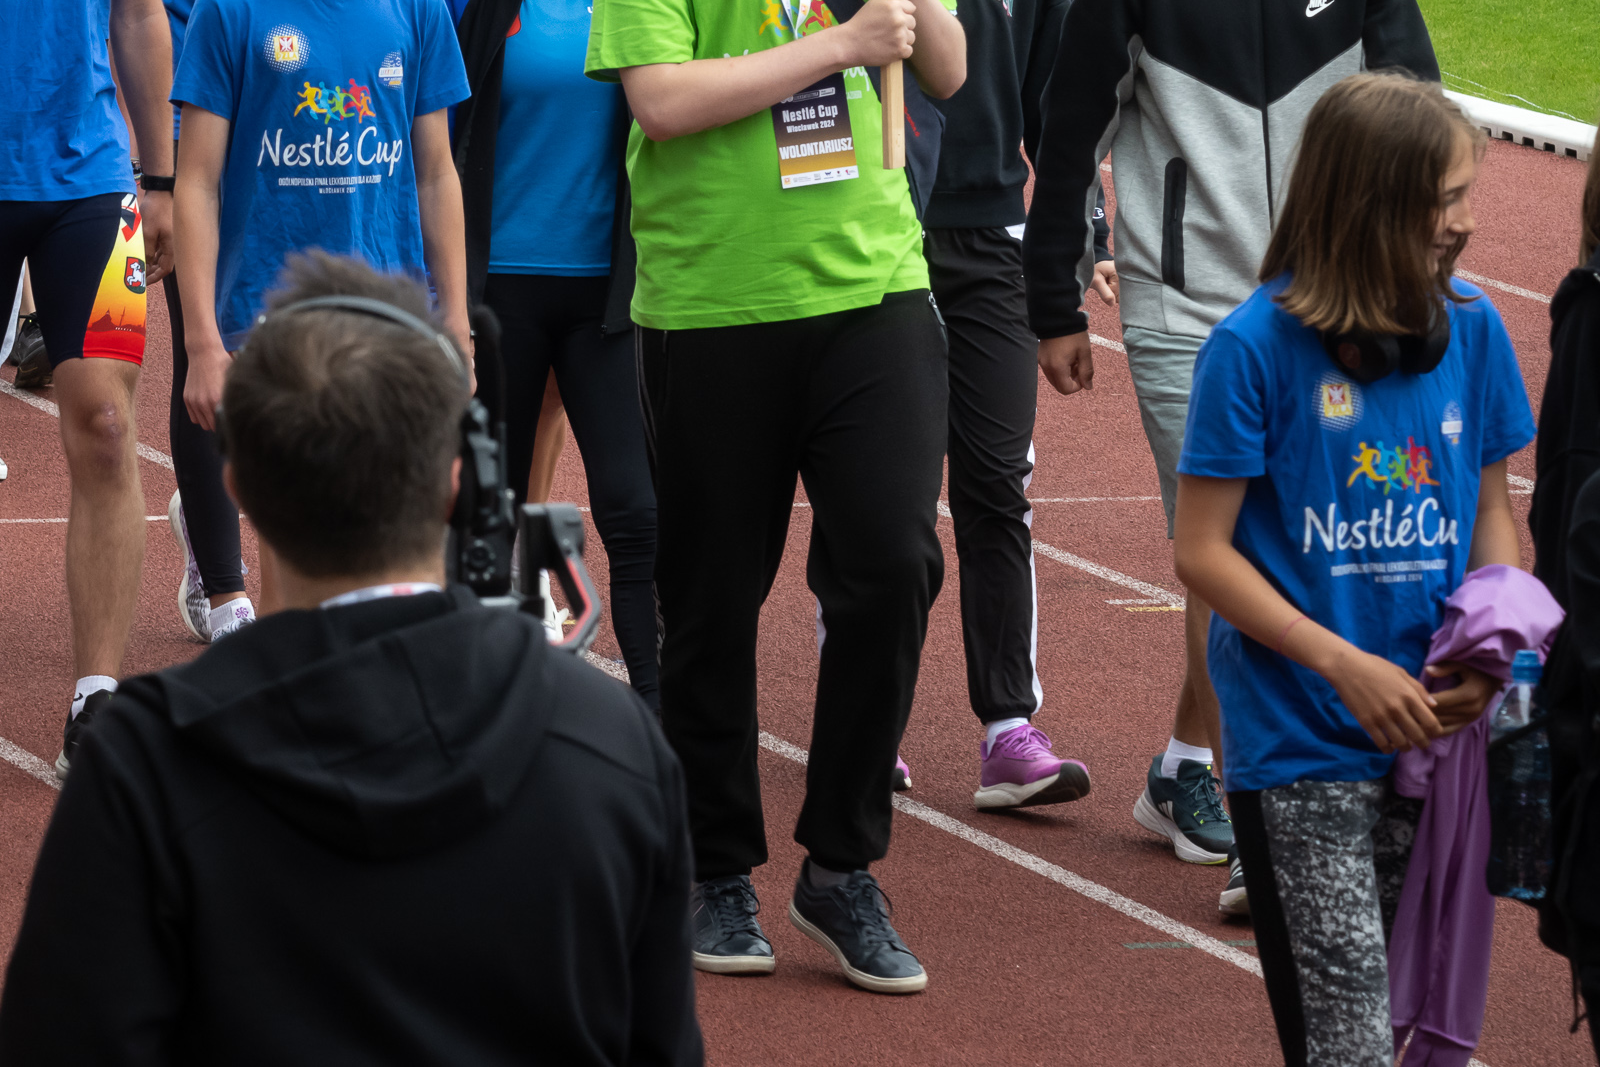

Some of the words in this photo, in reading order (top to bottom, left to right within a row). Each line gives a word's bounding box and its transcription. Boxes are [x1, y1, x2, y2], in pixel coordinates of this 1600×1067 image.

[782, 105, 816, 123] Nestlé
[818, 104, 838, 118] Cup
[786, 121, 820, 133] Włocławek
[820, 119, 835, 129] 2024
[257, 127, 353, 167] Nestlé
[356, 125, 402, 177] Cup
[779, 137, 853, 160] WOLONTARIUSZ
[1303, 498, 1412, 554] Nestlé
[1417, 497, 1460, 547] Cu
